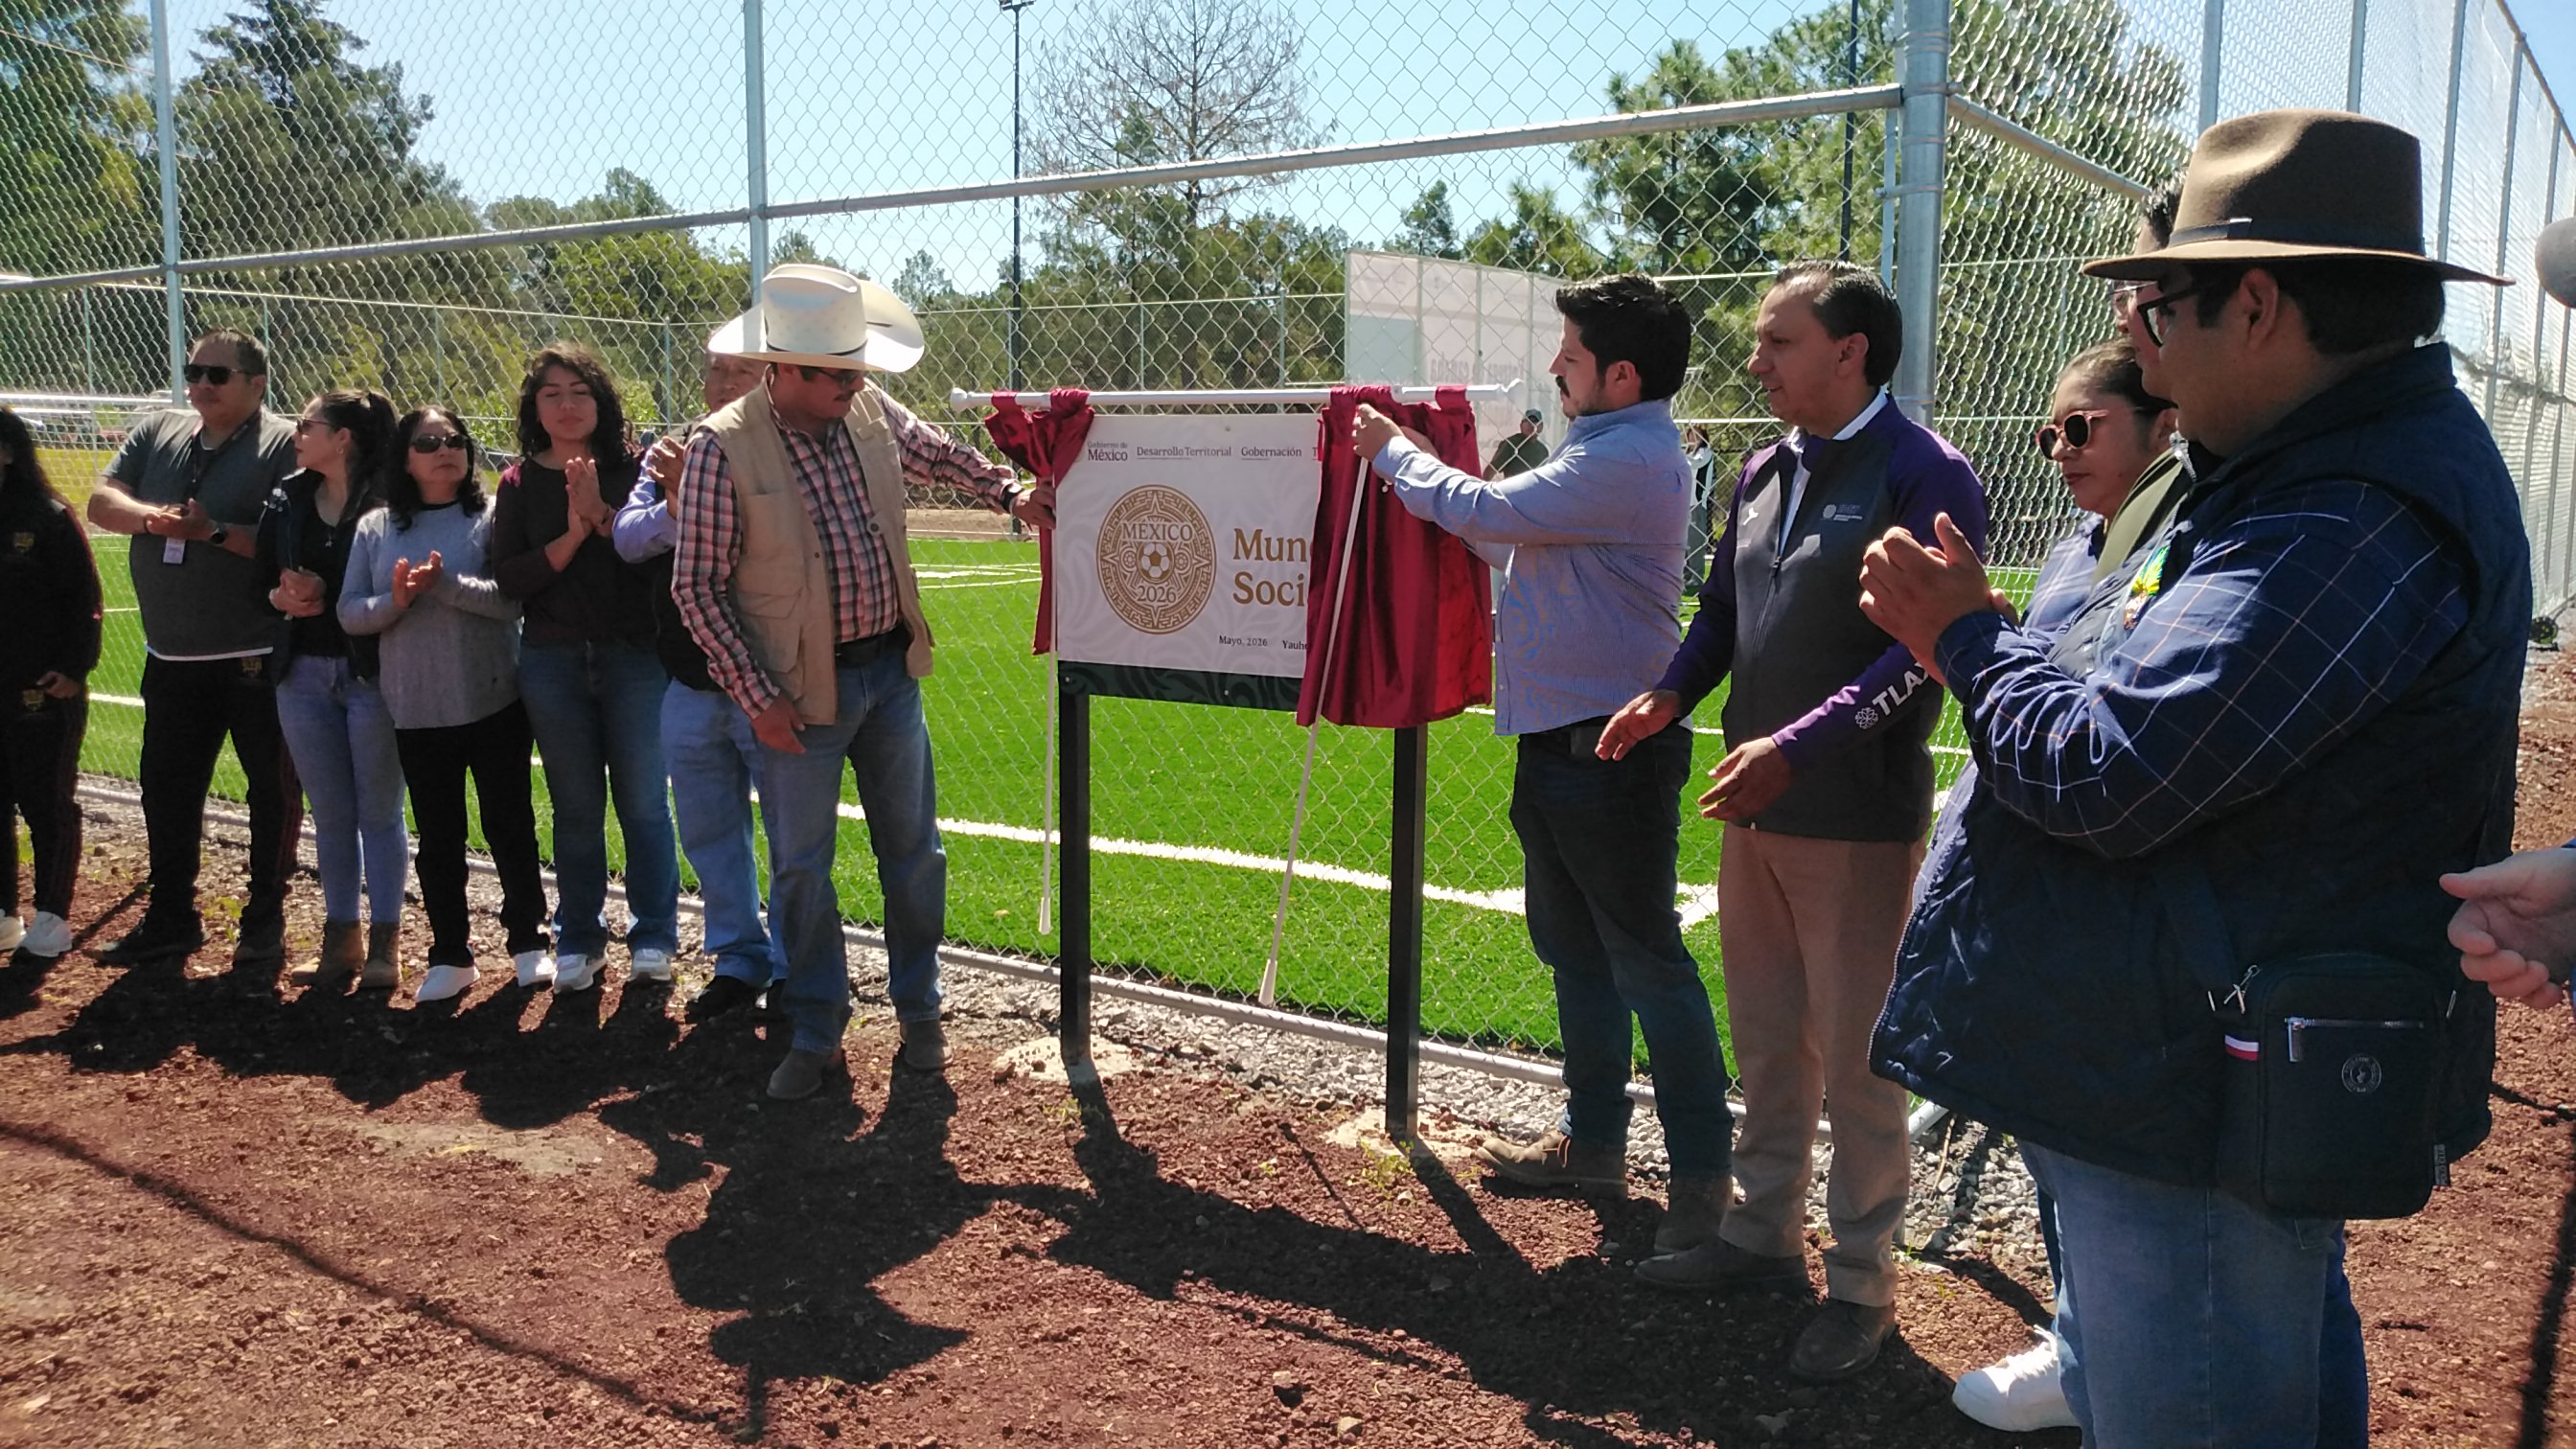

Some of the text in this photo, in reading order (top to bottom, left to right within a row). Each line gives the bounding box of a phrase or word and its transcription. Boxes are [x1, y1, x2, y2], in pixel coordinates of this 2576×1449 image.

[1088, 448, 1129, 462] México
[1136, 446, 1232, 457] Desarrollo Territorial
[1241, 446, 1302, 458] Gobernación
[1232, 528, 1307, 562] Mun
[1137, 585, 1178, 604] 2026
[1232, 571, 1306, 607] Soci
[1247, 637, 1269, 647] 2026
